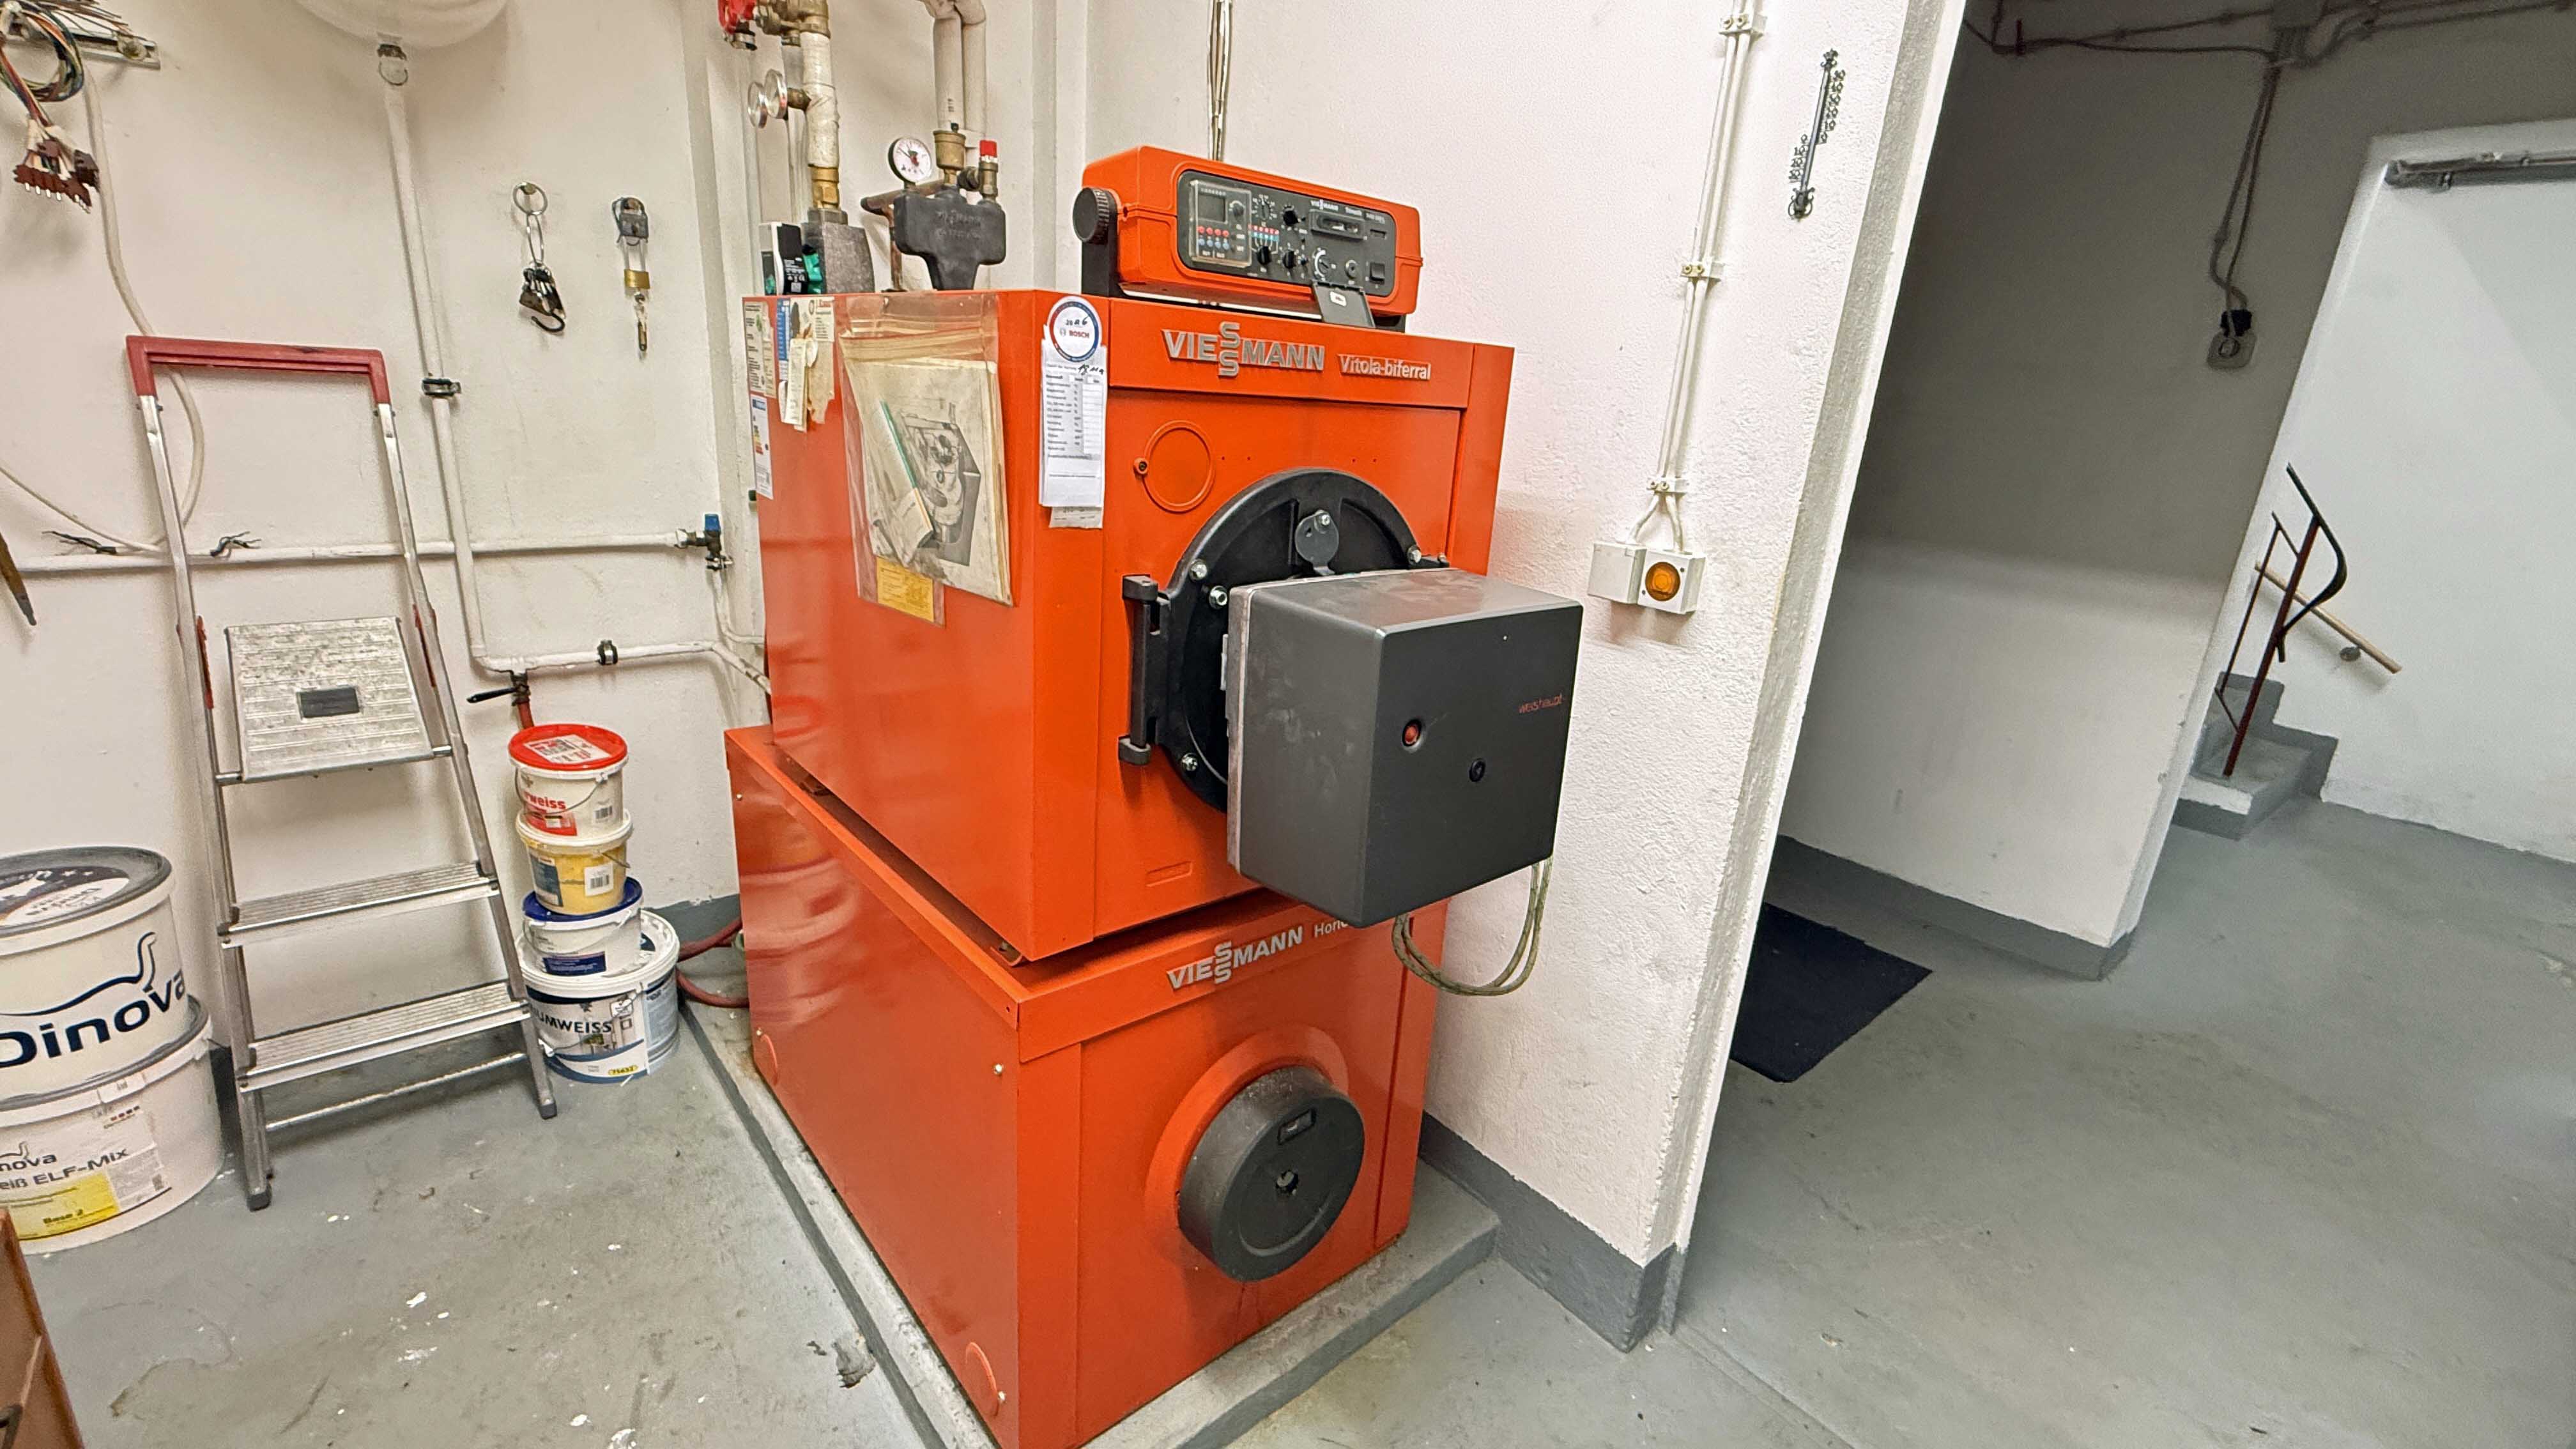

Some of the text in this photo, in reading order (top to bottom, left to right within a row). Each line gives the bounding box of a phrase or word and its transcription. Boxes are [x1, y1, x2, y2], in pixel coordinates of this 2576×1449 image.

[1794, 146, 1805, 156] 10
[1069, 330, 1090, 338] BOSCH
[1162, 321, 1432, 381] VIESSMANN Vitola-biferral
[1167, 926, 1304, 990] VIESSMANN
[0, 968, 186, 1068] Dinova
